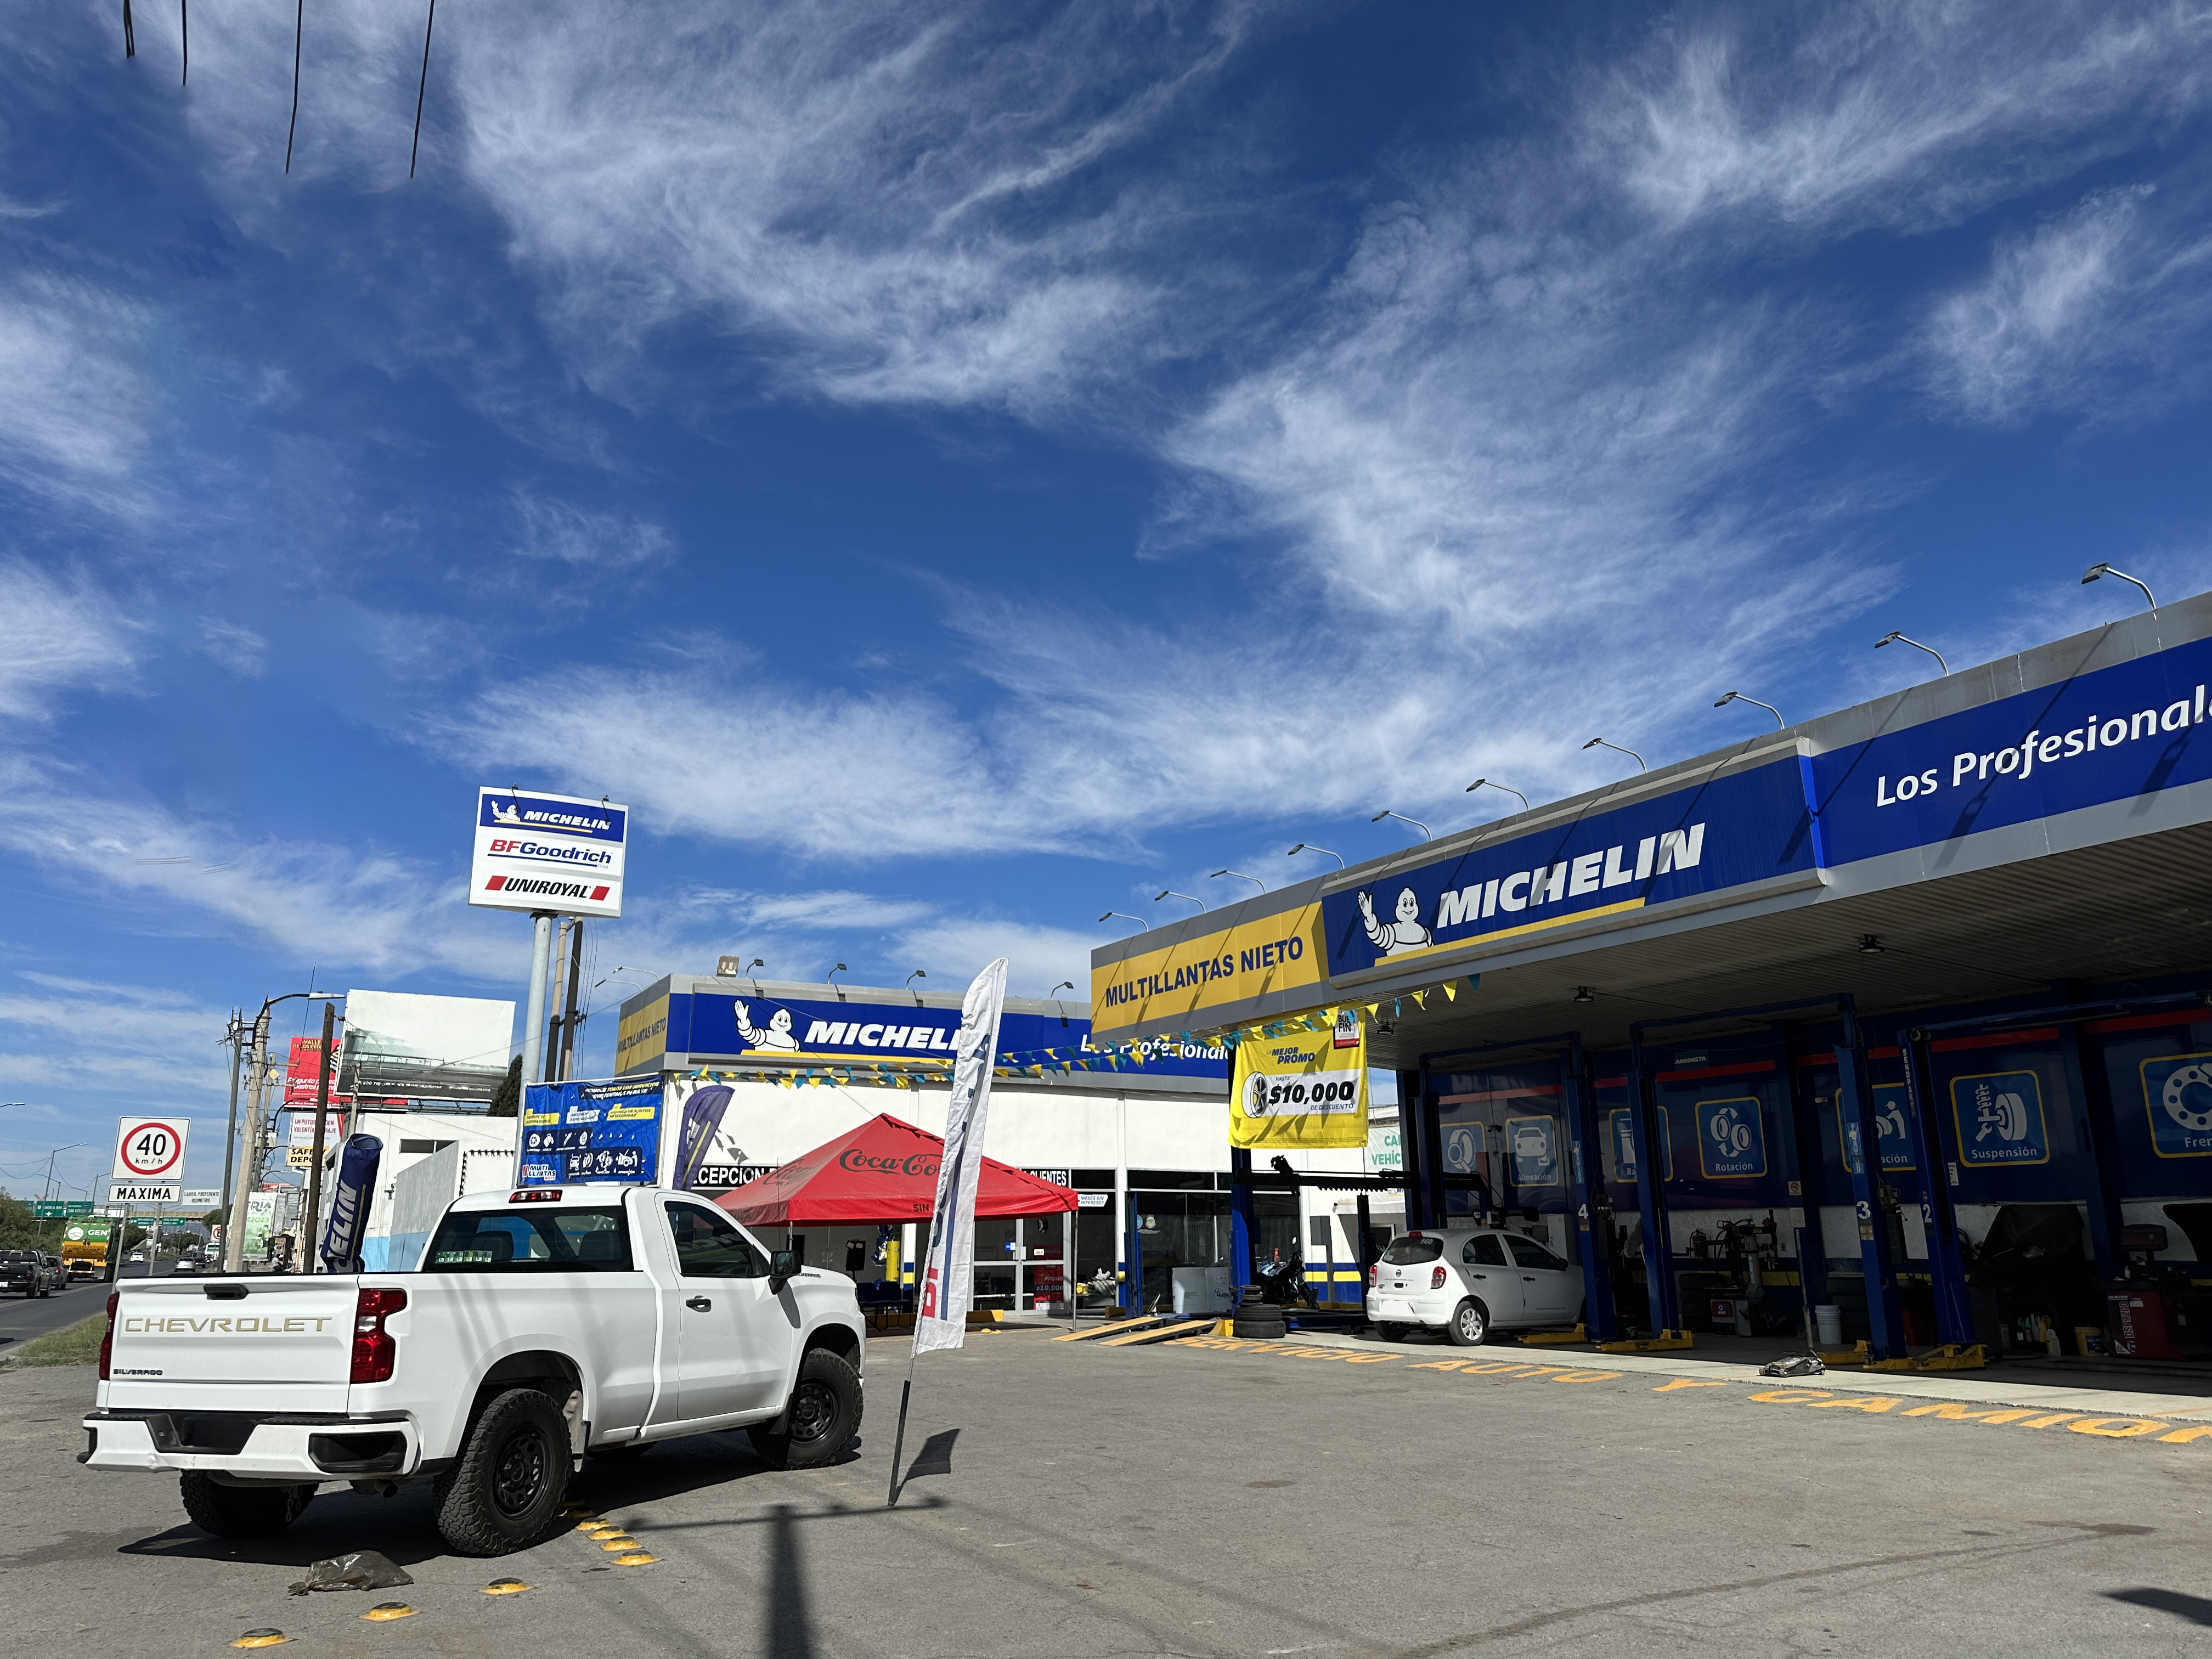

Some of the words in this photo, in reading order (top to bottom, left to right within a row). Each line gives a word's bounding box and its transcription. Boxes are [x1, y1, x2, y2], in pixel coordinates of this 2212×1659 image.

[1877, 769, 1938, 807] Los
[523, 810, 611, 830] MICHELIN
[489, 839, 612, 864] BFGoodrich
[1437, 822, 1705, 929] MICHELIN
[505, 878, 589, 898] UNIROYAL
[1106, 954, 1234, 1007] MULTILLANTAS
[1241, 936, 1302, 973] NIETO
[1338, 1015, 1355, 1023] BUE
[618, 1026, 651, 1054] MULTILLANTAS
[651, 1017, 666, 1036] NIETO
[804, 1021, 961, 1050] MICHELI
[1272, 1047, 1299, 1056] MEJOR
[1277, 1052, 1315, 1064] PROMO
[1268, 1081, 1355, 1107] $10,000
[137, 1133, 167, 1156] 40
[1849, 1123, 1861, 1173] FORWRD
[1971, 1146, 2038, 1160] Suspensión
[839, 1149, 943, 1176] Coca-Co
[1716, 1162, 1753, 1172] Rotación
[1880, 1154, 1908, 1164] ación
[1517, 1172, 1551, 1181] Alineación
[117, 1187, 171, 1200] MAXIMA
[913, 1204, 929, 1212] SIN
[1578, 1204, 1589, 1219] 4
[1857, 1201, 1871, 1220] 3
[1923, 1204, 1932, 1223] 2
[125, 1317, 332, 1332] CHEVROLET
[2119, 1301, 2135, 1339] DSP9200
[1163, 1336, 1404, 1363] SERVICIO
[1406, 1359, 1623, 1383] AUTO
[1651, 1378, 1729, 1392] Y
